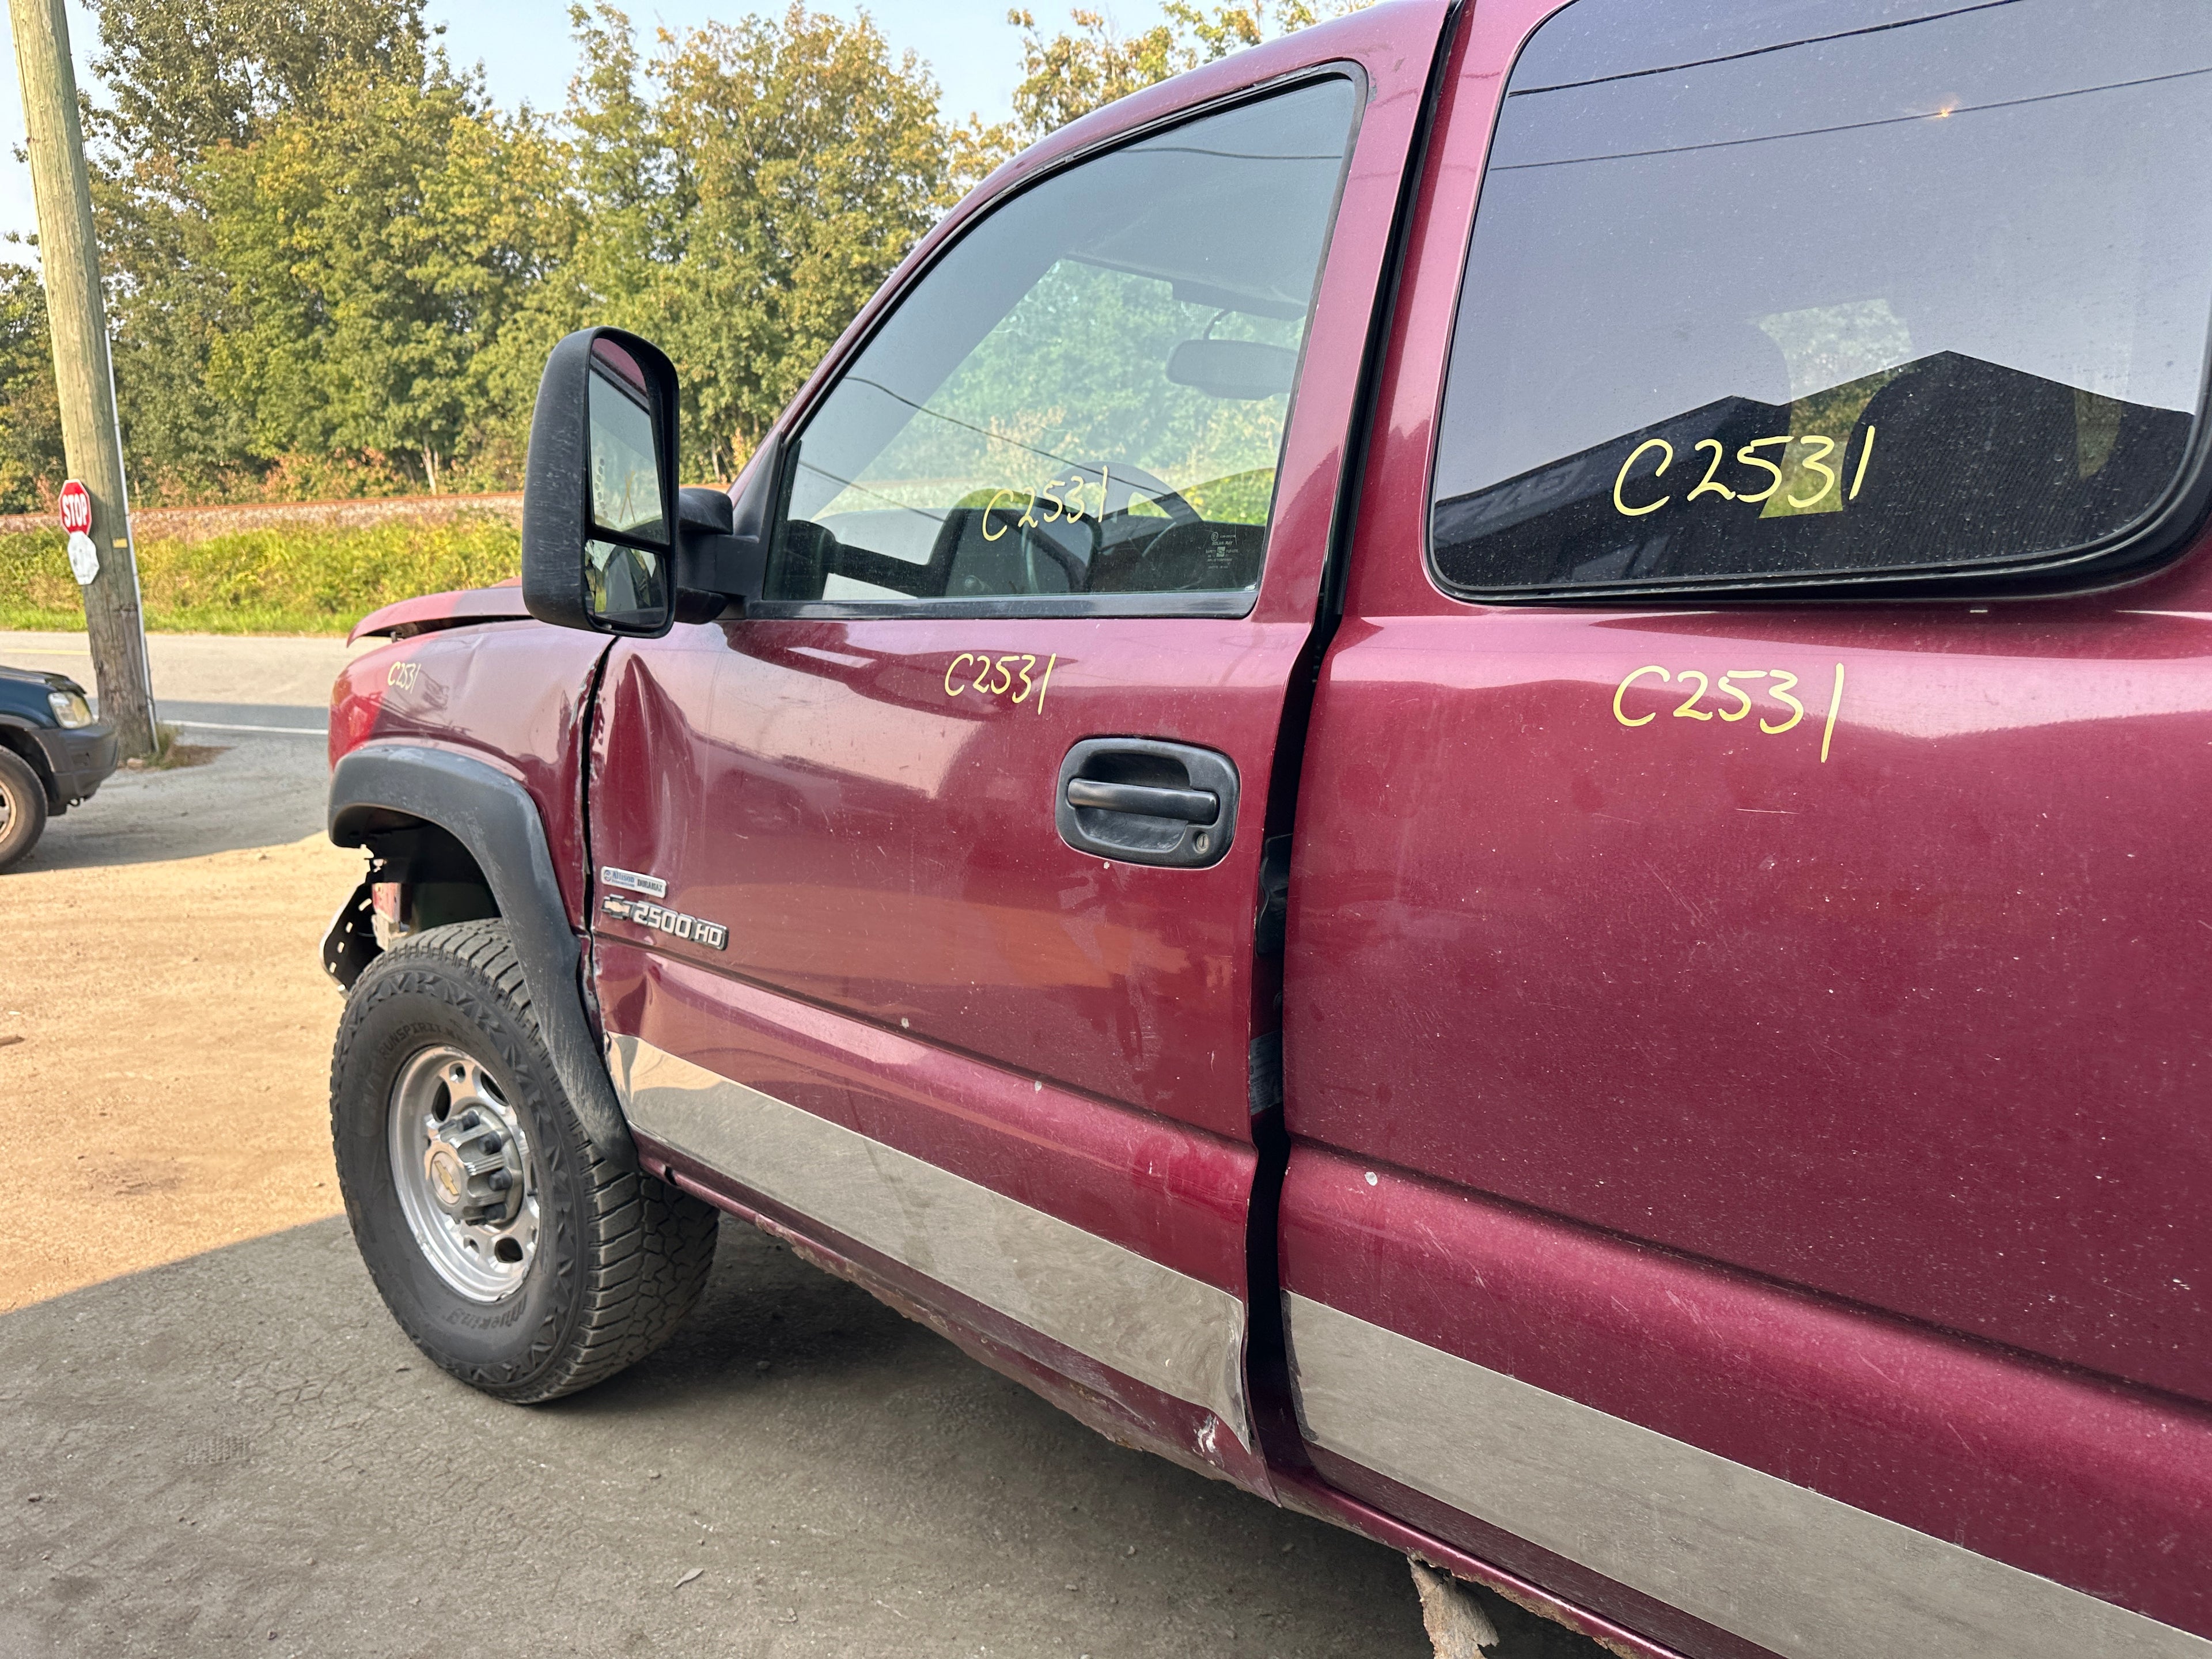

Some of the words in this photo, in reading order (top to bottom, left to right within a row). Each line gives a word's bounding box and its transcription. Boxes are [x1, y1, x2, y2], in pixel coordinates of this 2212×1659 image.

[1613, 425, 1876, 516] C2531
[62, 493, 88, 527] STOP
[982, 465, 1108, 541] C2531
[387, 661, 422, 694] C2531
[944, 653, 1056, 715] C2531
[1613, 662, 1844, 763] C2531
[612, 870, 635, 882] Allison
[637, 878, 662, 892] DURAMAX
[633, 903, 692, 938] 2500
[695, 923, 723, 946] HD
